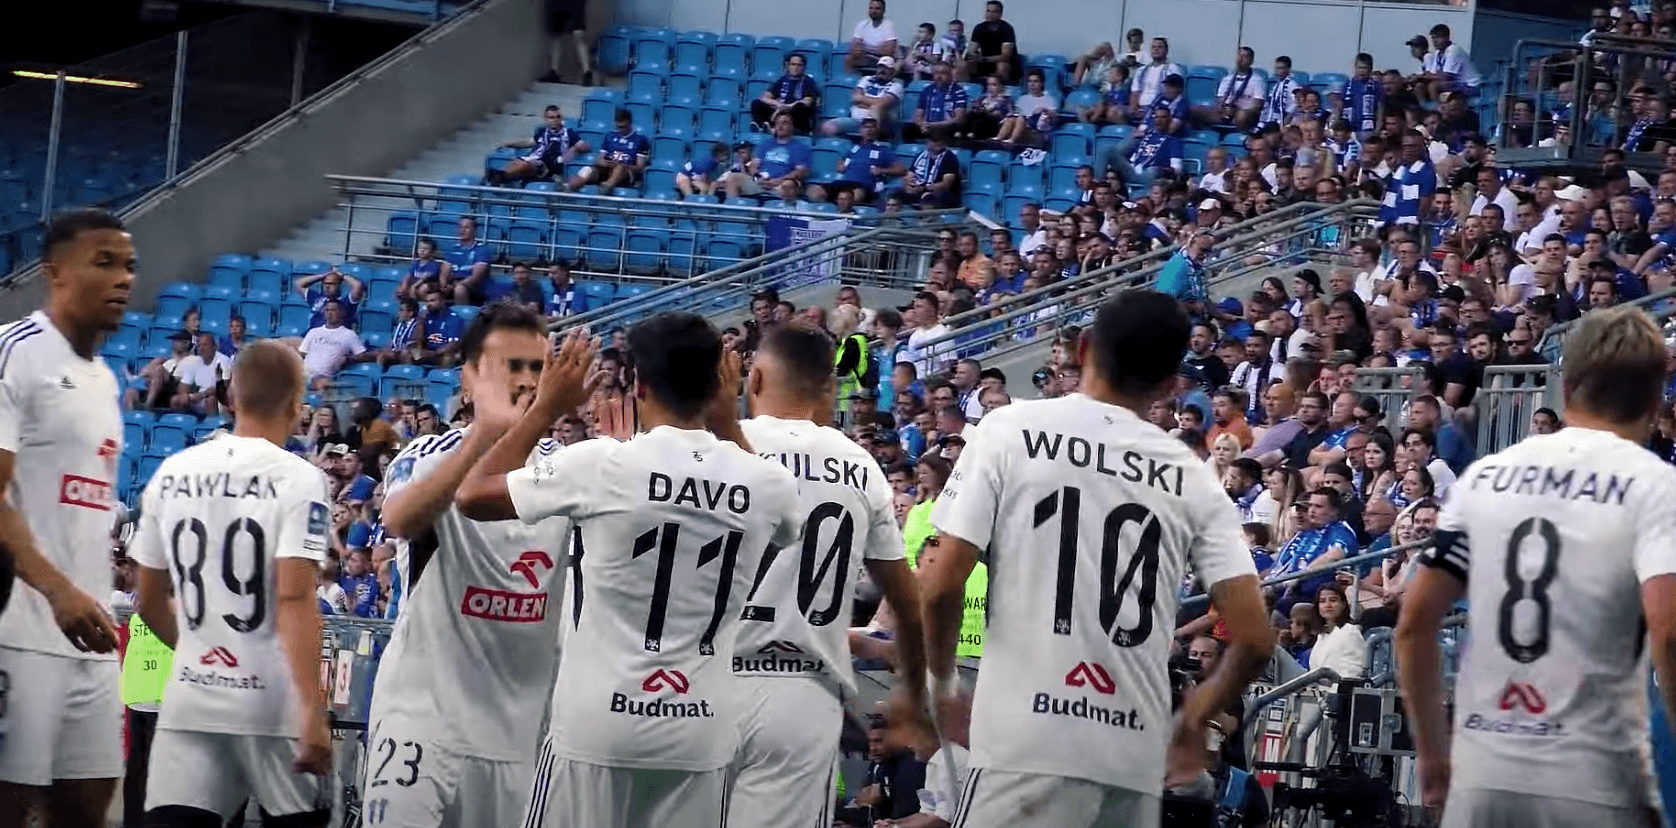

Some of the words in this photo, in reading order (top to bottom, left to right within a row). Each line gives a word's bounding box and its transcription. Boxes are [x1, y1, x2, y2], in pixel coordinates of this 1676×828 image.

[759, 452, 868, 492] ULSKI
[1022, 428, 1184, 496] WOLSKI
[160, 473, 281, 499] PAWLAK
[648, 471, 751, 515] DAVO
[1471, 465, 1636, 505] FURMAN
[171, 517, 266, 634] 89
[1033, 486, 1162, 648] 10
[468, 592, 545, 618] ORLEN
[632, 522, 745, 656] 11
[963, 597, 987, 611] WAR
[1497, 516, 1562, 664] 8
[134, 624, 152, 637] STE
[143, 660, 157, 671] 30
[610, 692, 714, 718] Budmat.
[1033, 692, 1144, 731] Budmat.
[371, 737, 423, 787] 23
